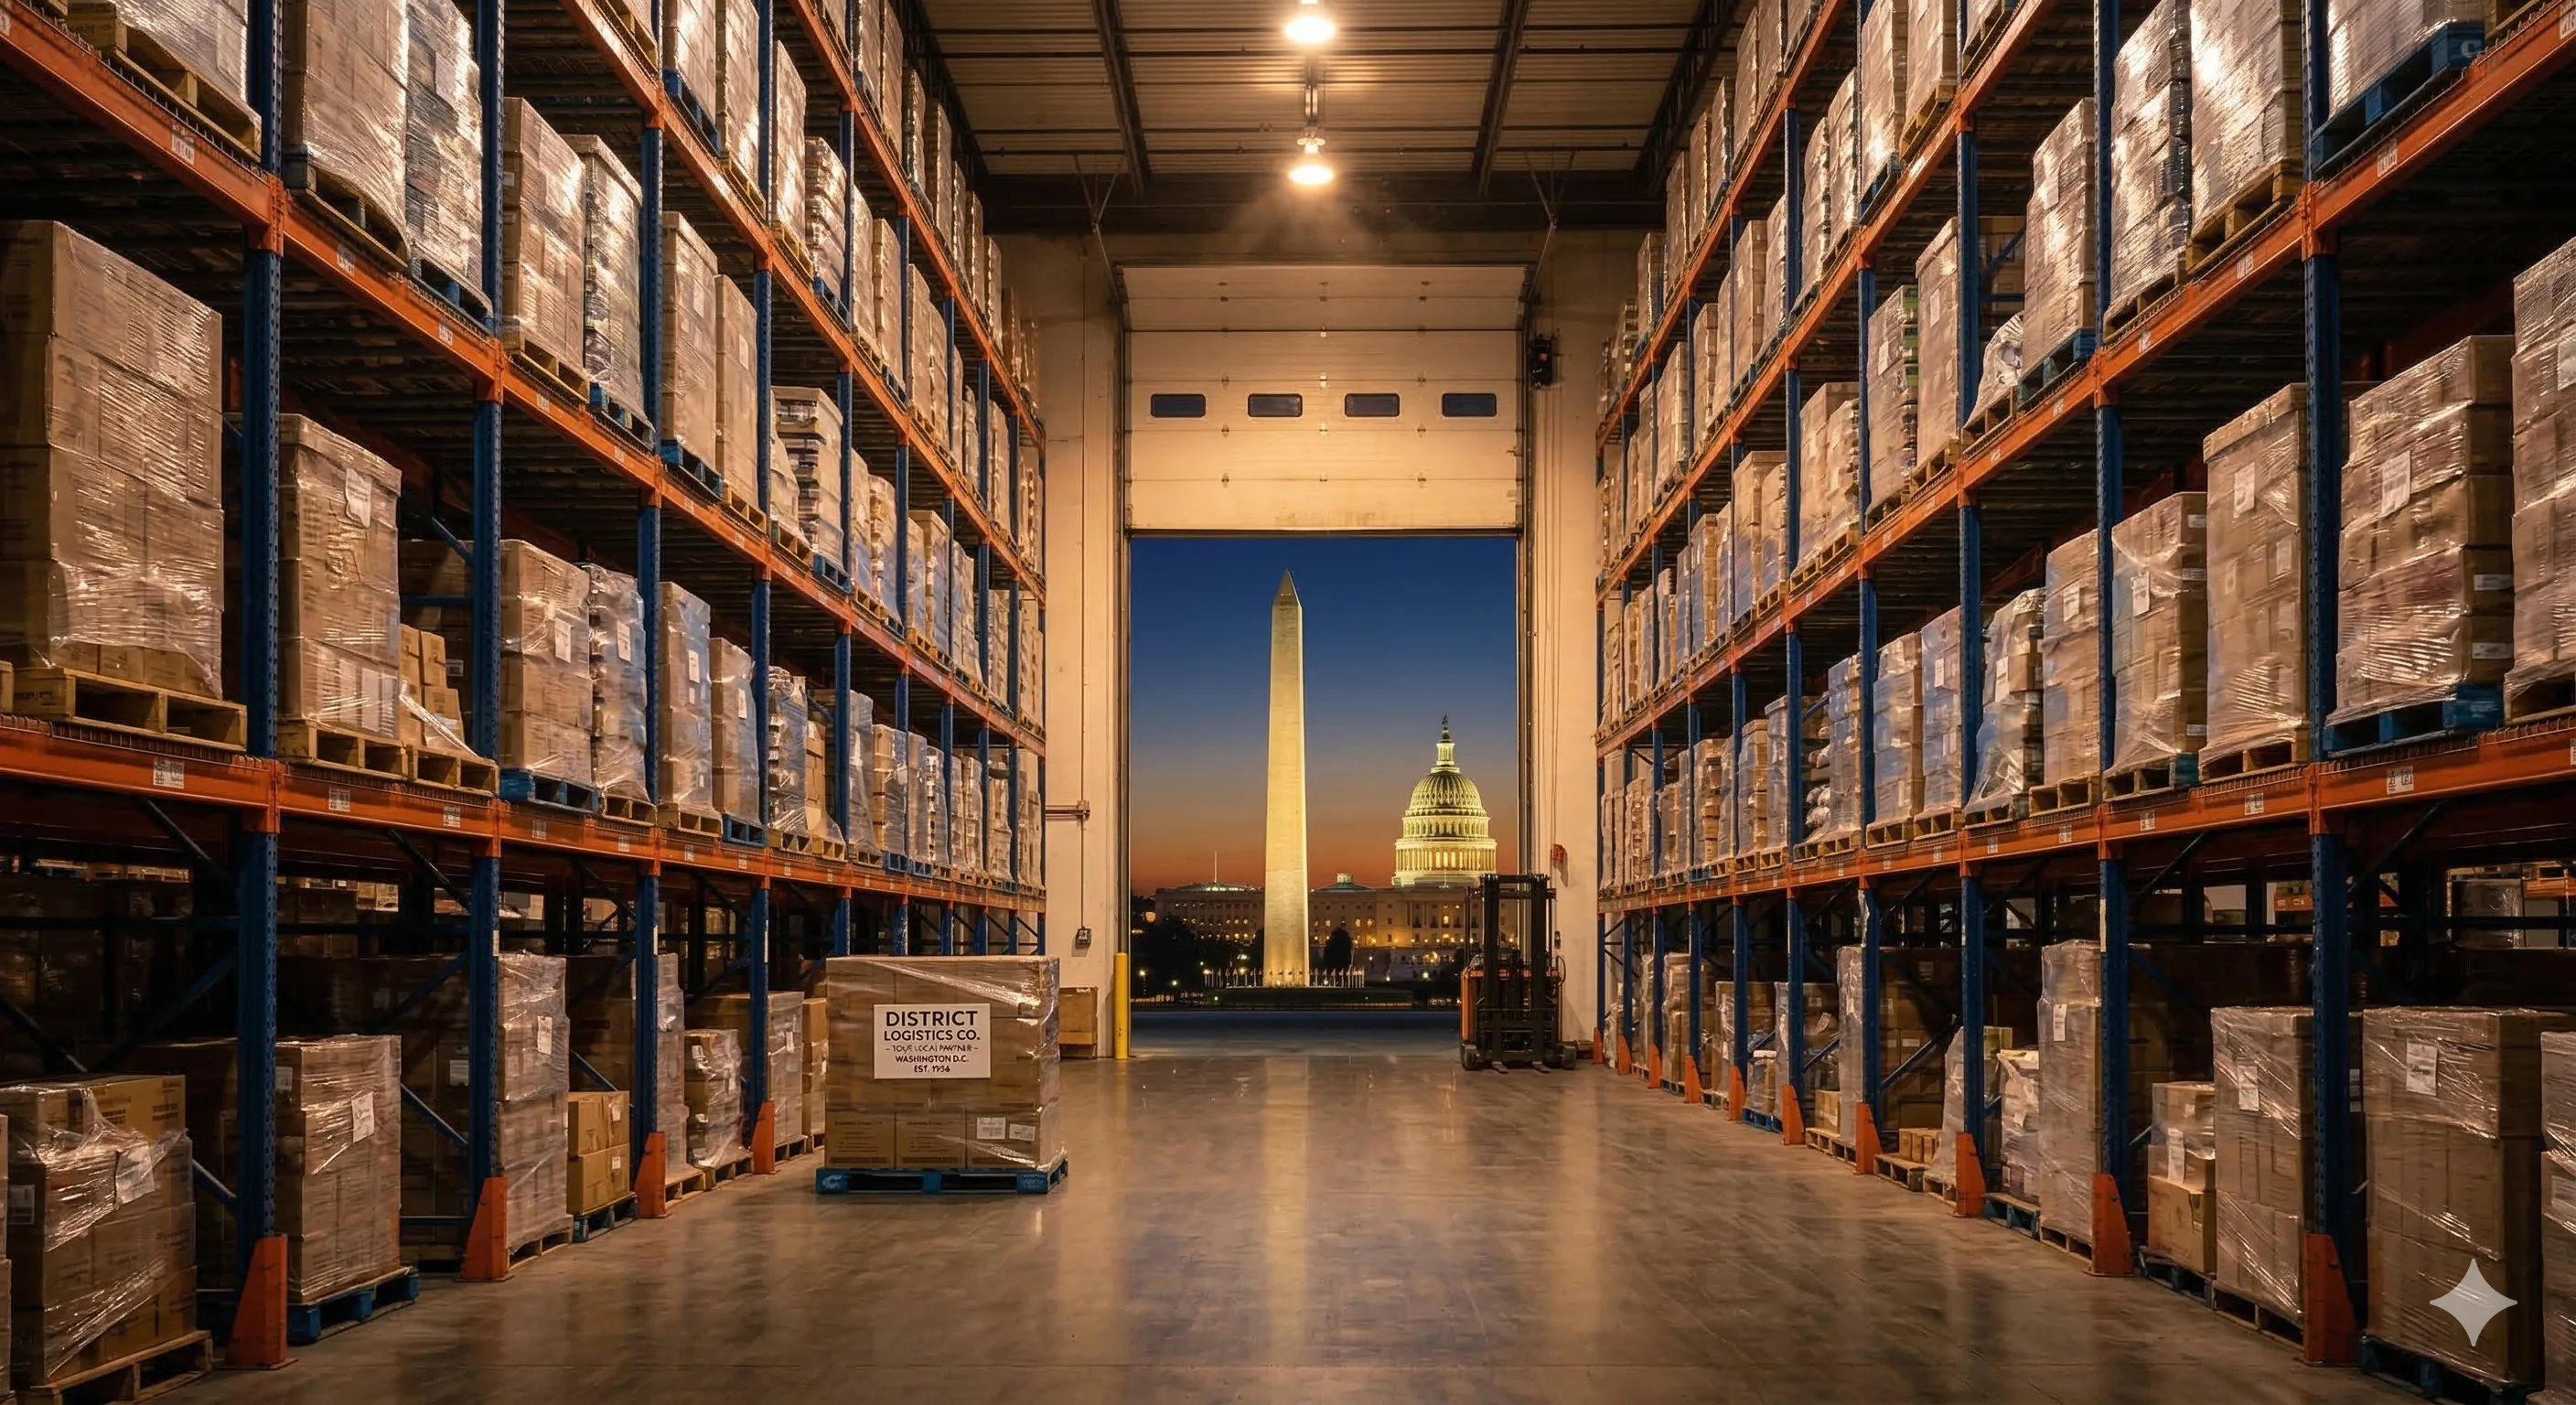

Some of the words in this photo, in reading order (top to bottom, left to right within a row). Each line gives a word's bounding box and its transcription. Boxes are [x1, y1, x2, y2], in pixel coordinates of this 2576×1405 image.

[886, 1011, 978, 1026] DISTRICT
[884, 1030, 953, 1041] LOGISTICS
[956, 1029, 981, 1040] CO.
[895, 1055, 951, 1063] WASHINGTON
[952, 1055, 970, 1063] D.C.
[914, 1065, 929, 1073] EST.
